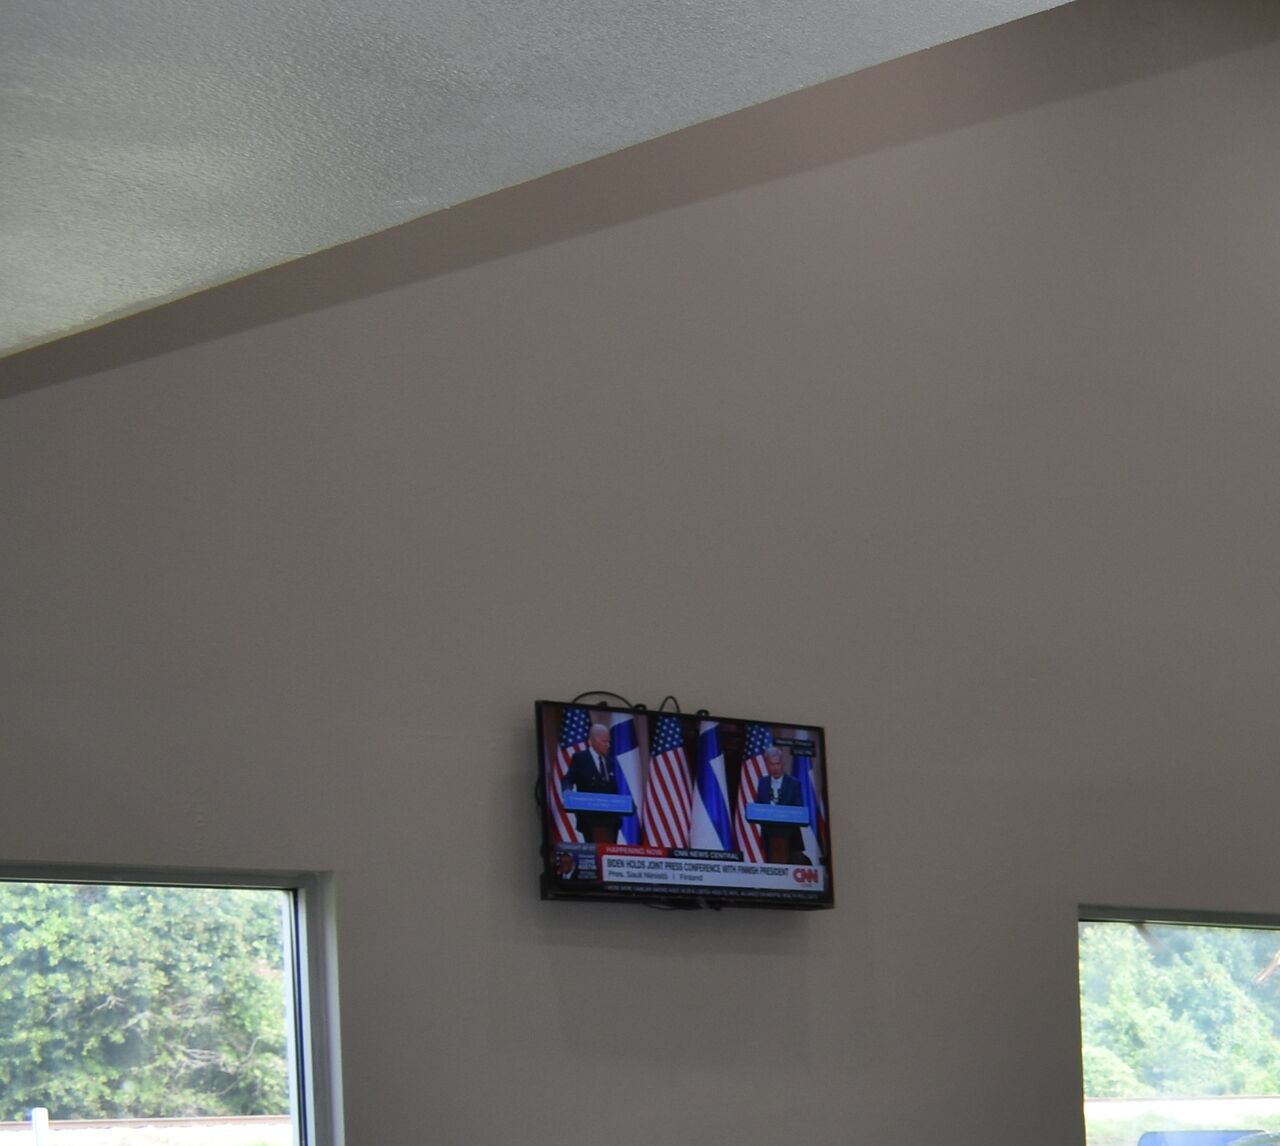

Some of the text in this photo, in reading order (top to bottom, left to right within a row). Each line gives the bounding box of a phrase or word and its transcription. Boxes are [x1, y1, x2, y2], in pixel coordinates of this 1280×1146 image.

[710, 851, 739, 860] CENTRAL
[607, 859, 624, 868] BIDEN
[627, 860, 646, 869] HOLDS
[648, 861, 663, 869] JOINT
[665, 862, 682, 871] PRESS
[684, 863, 720, 873] CONFERENCE
[793, 868, 819, 883] CNN
